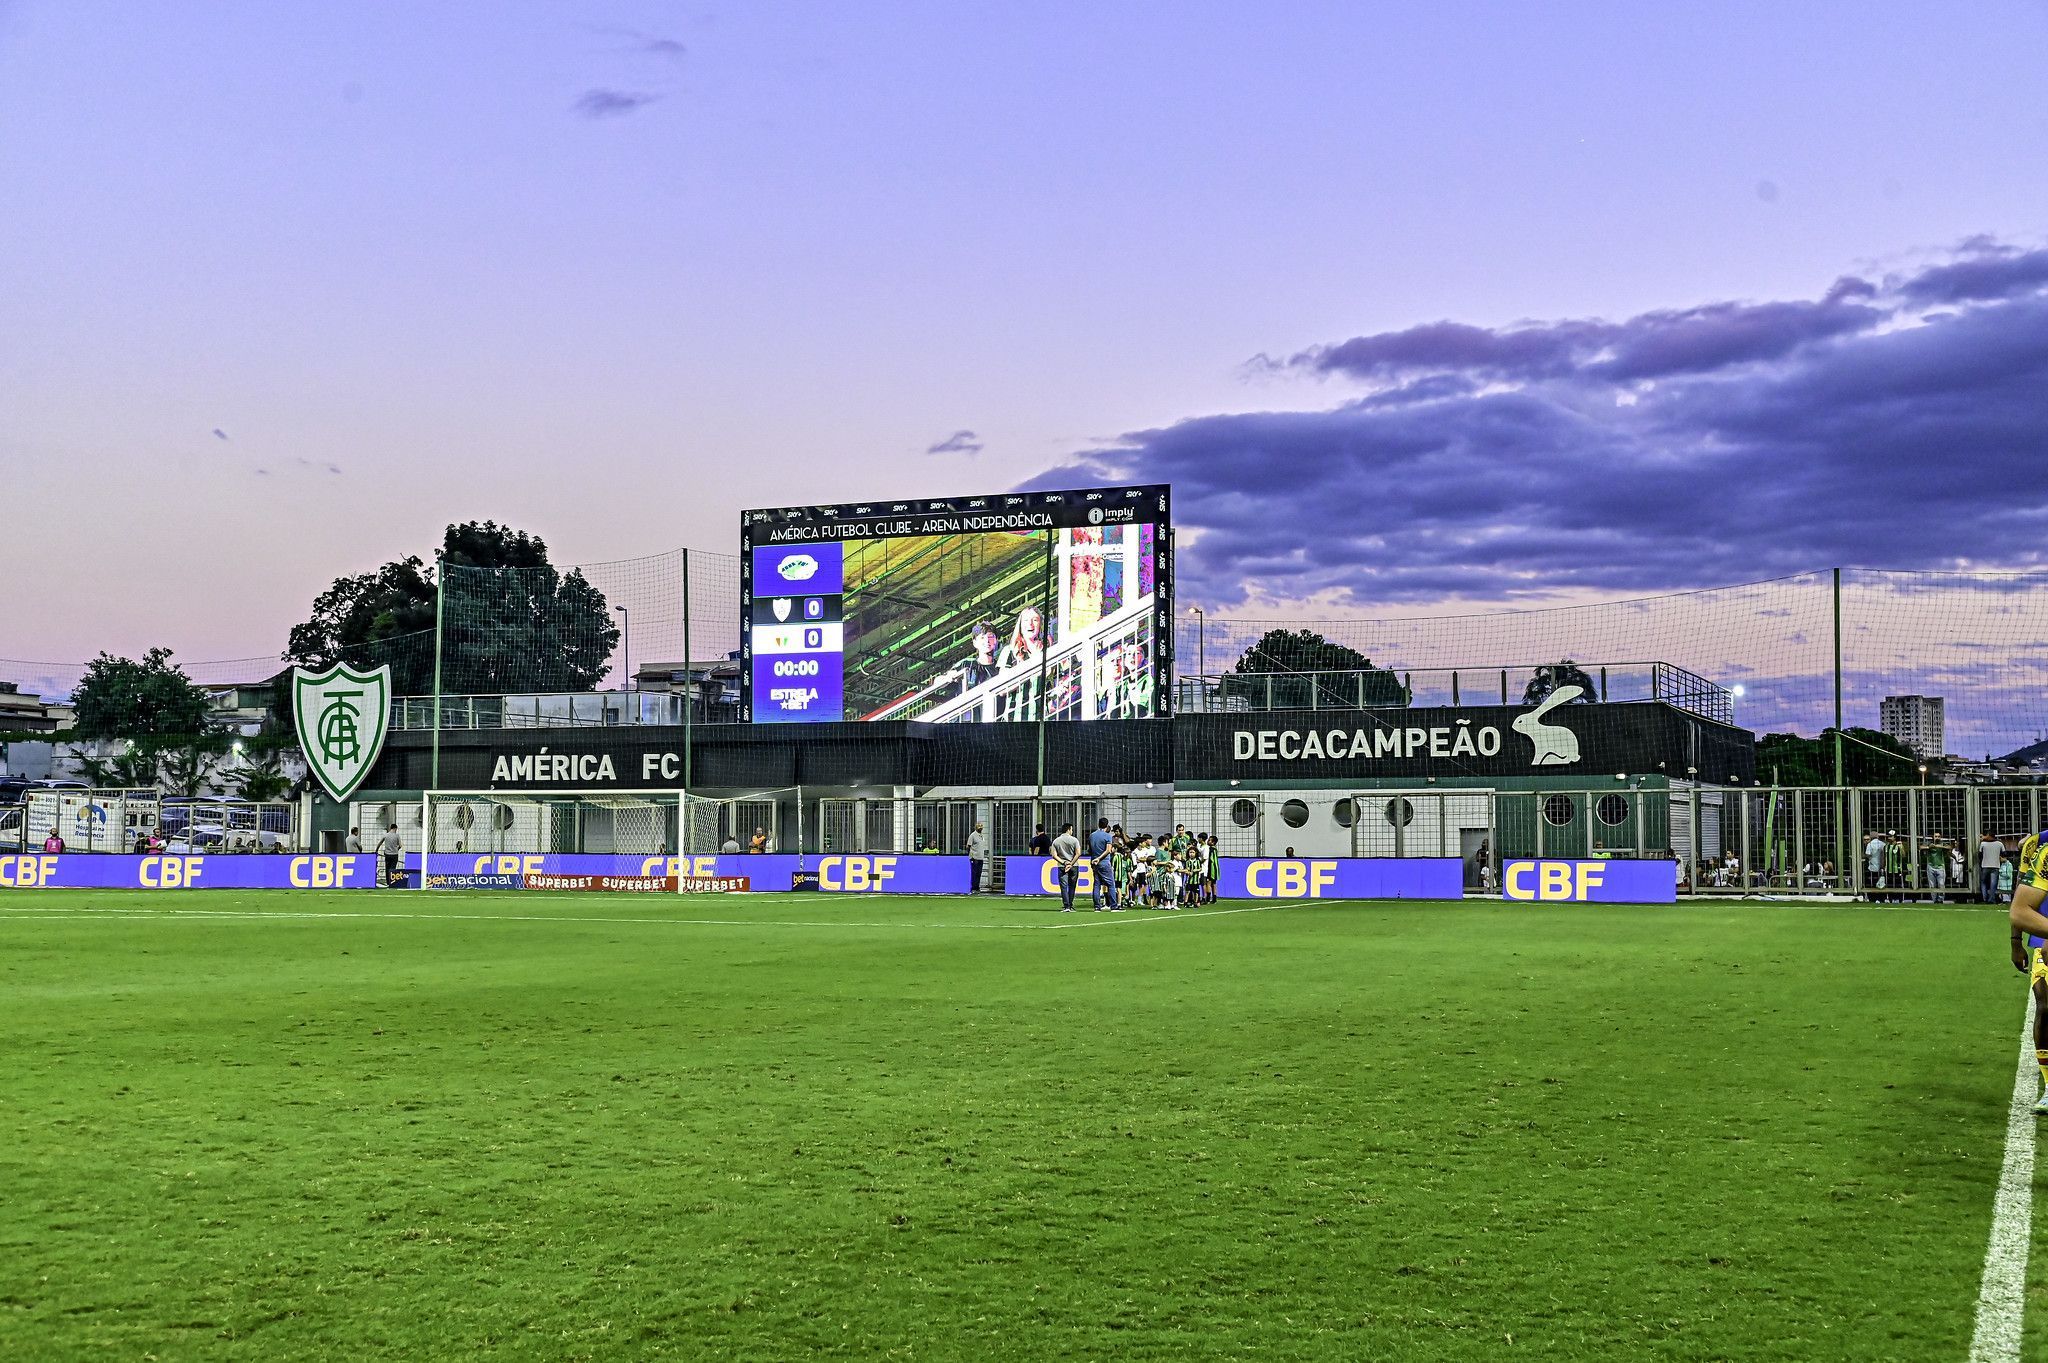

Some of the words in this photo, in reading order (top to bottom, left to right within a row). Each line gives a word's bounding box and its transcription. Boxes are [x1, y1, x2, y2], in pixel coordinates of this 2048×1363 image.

[770, 525, 819, 541] AMÉRICA
[822, 524, 872, 540] FUTEBOL
[876, 521, 912, 538] CLUBE
[922, 519, 961, 535] ARENA
[963, 512, 1053, 532] INDEPENDÊNCIA
[809, 601, 819, 615] 0
[808, 631, 818, 645] 0
[774, 660, 818, 676] 00:00
[1235, 719, 1500, 759] DECACAMPEÃO
[492, 747, 616, 780] AMÉRICA
[643, 753, 679, 779] FC
[74, 830, 104, 838] Resincia
[75, 824, 97, 832] Hospal
[0, 857, 58, 887] CBF
[140, 857, 203, 888] CBF
[290, 857, 355, 888] CBF
[529, 876, 592, 888] SUPERBET
[602, 877, 666, 889] SUPERBET
[817, 857, 897, 891] CBF
[1041, 859, 1095, 894] CB
[1246, 861, 1337, 897] CBF
[1506, 862, 1605, 900] CBF
